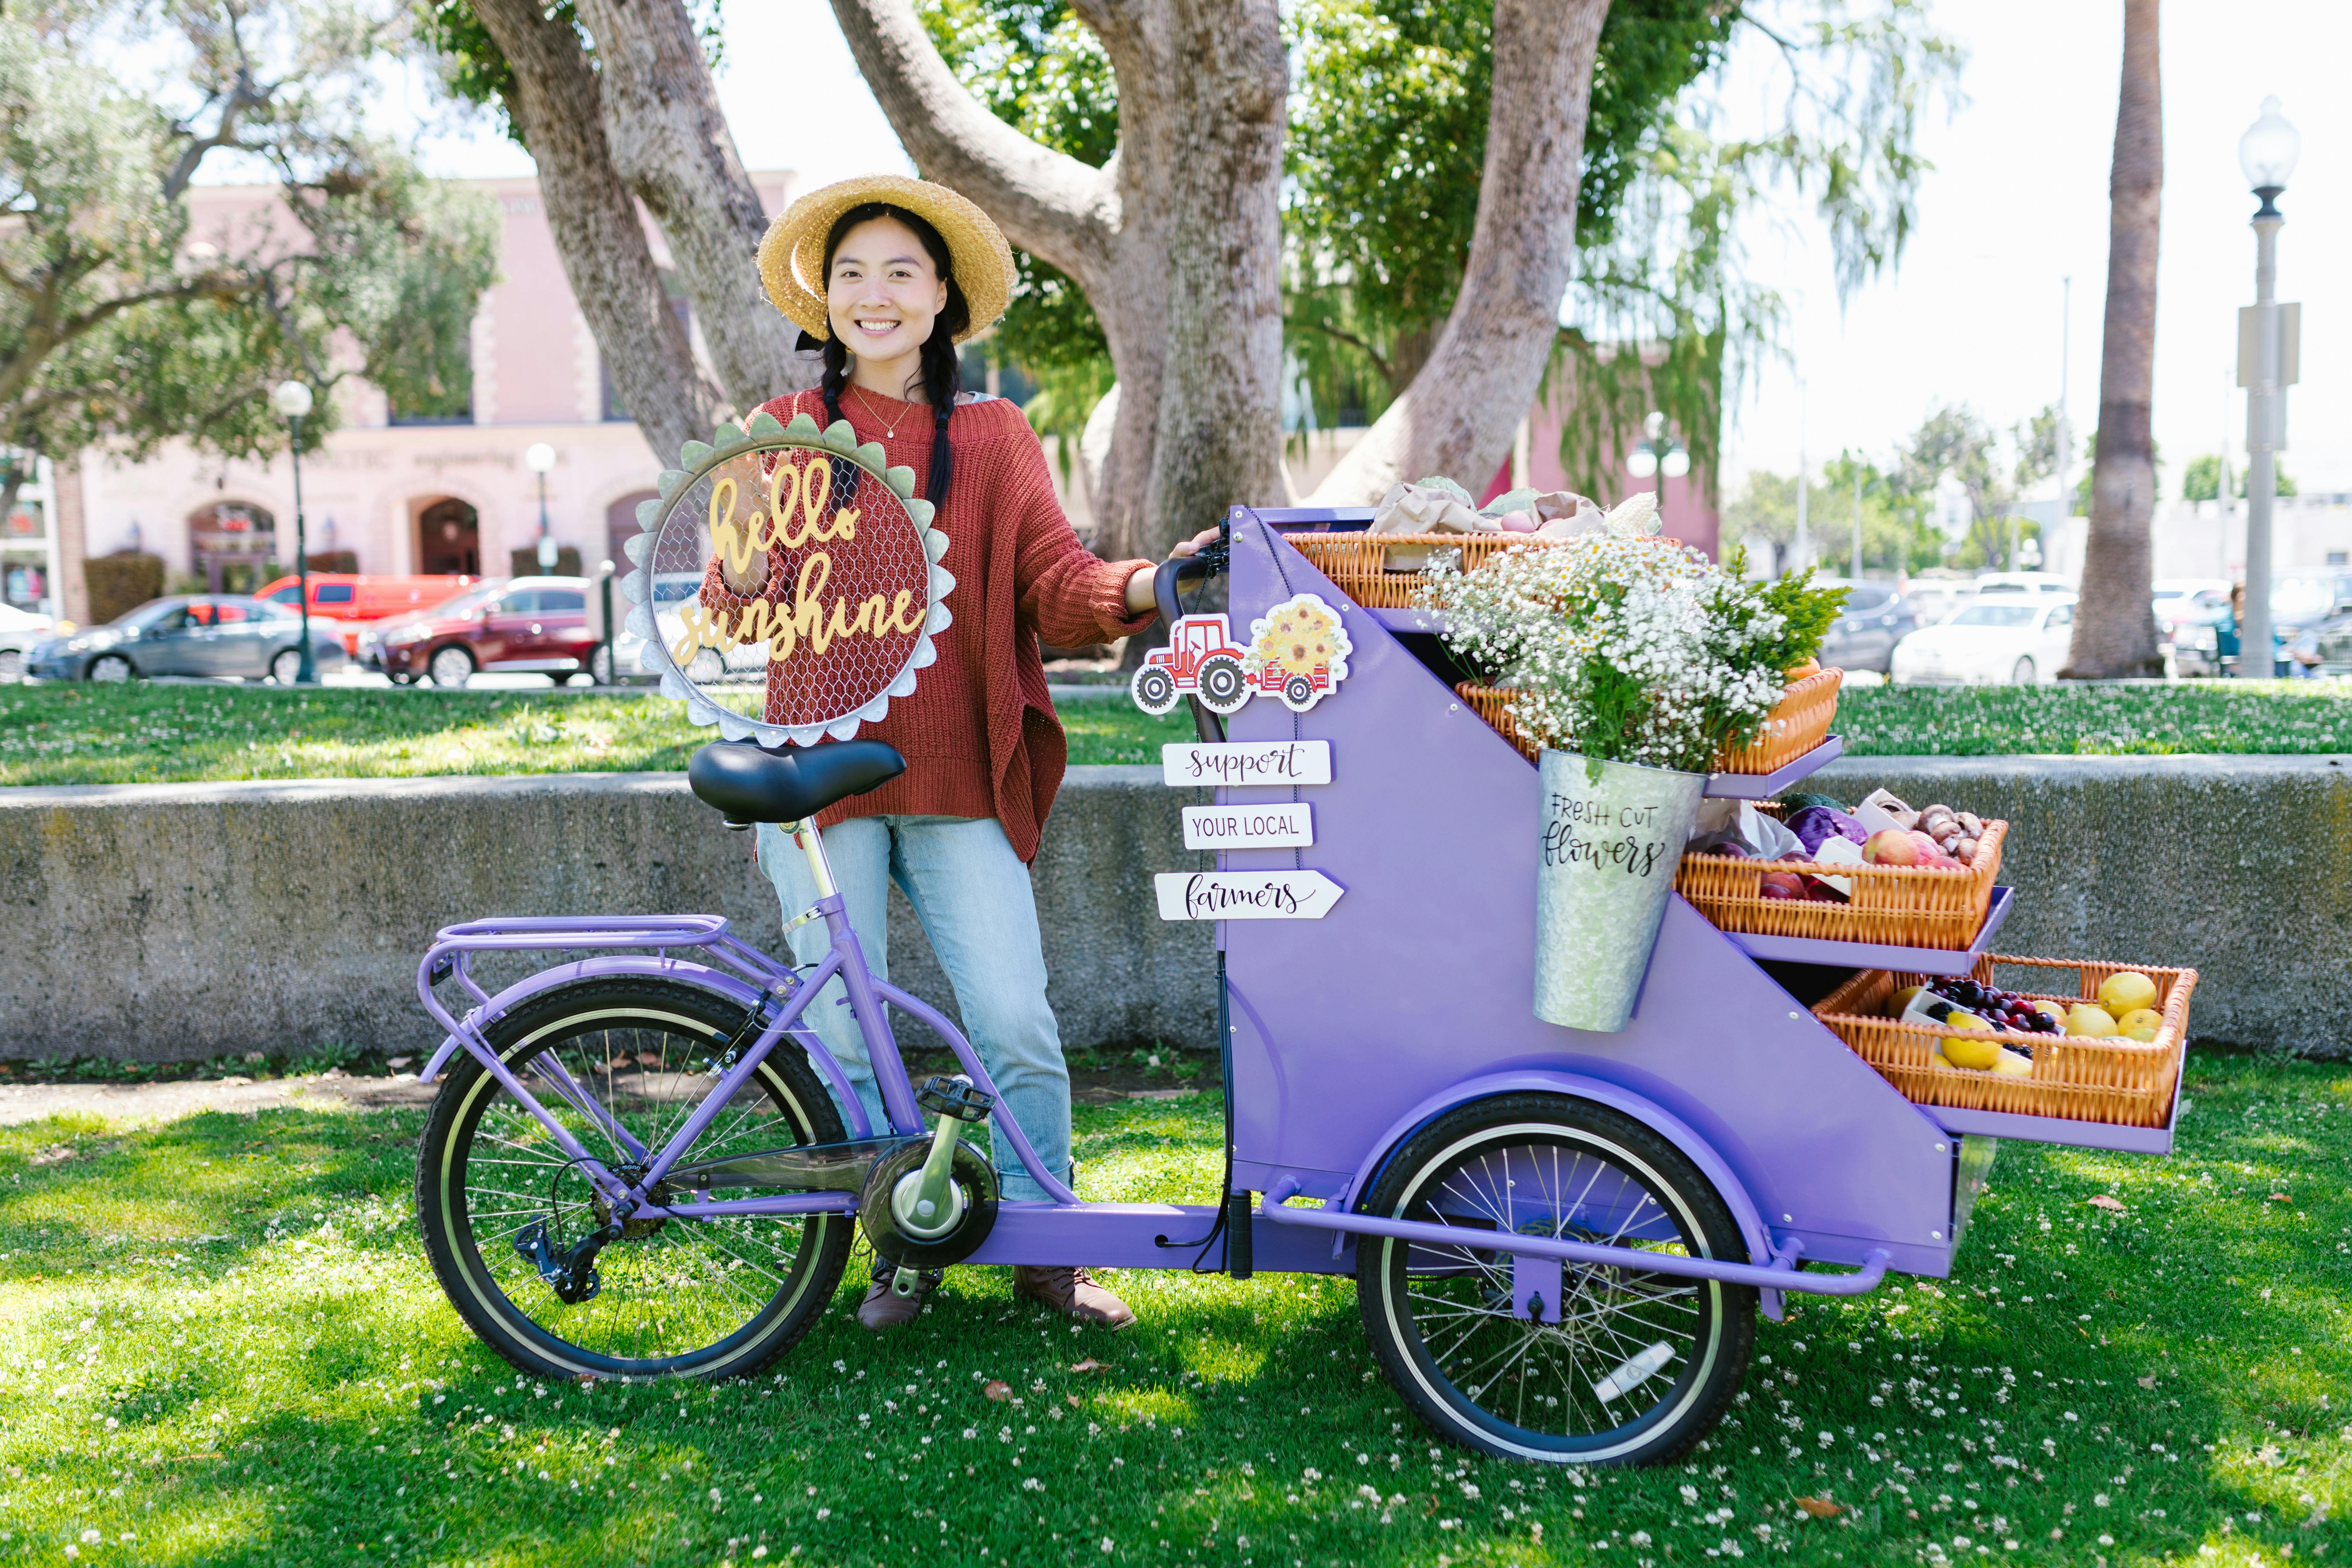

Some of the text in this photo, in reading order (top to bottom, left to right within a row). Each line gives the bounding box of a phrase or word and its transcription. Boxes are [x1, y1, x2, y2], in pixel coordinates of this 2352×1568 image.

[709, 458, 861, 575] hello
[674, 552, 926, 665] sunshine
[1185, 743, 1305, 782] support
[1192, 816, 1299, 837] YOUR LOCAL
[1541, 820, 1666, 877] flowers
[1186, 874, 1316, 919] farmers
